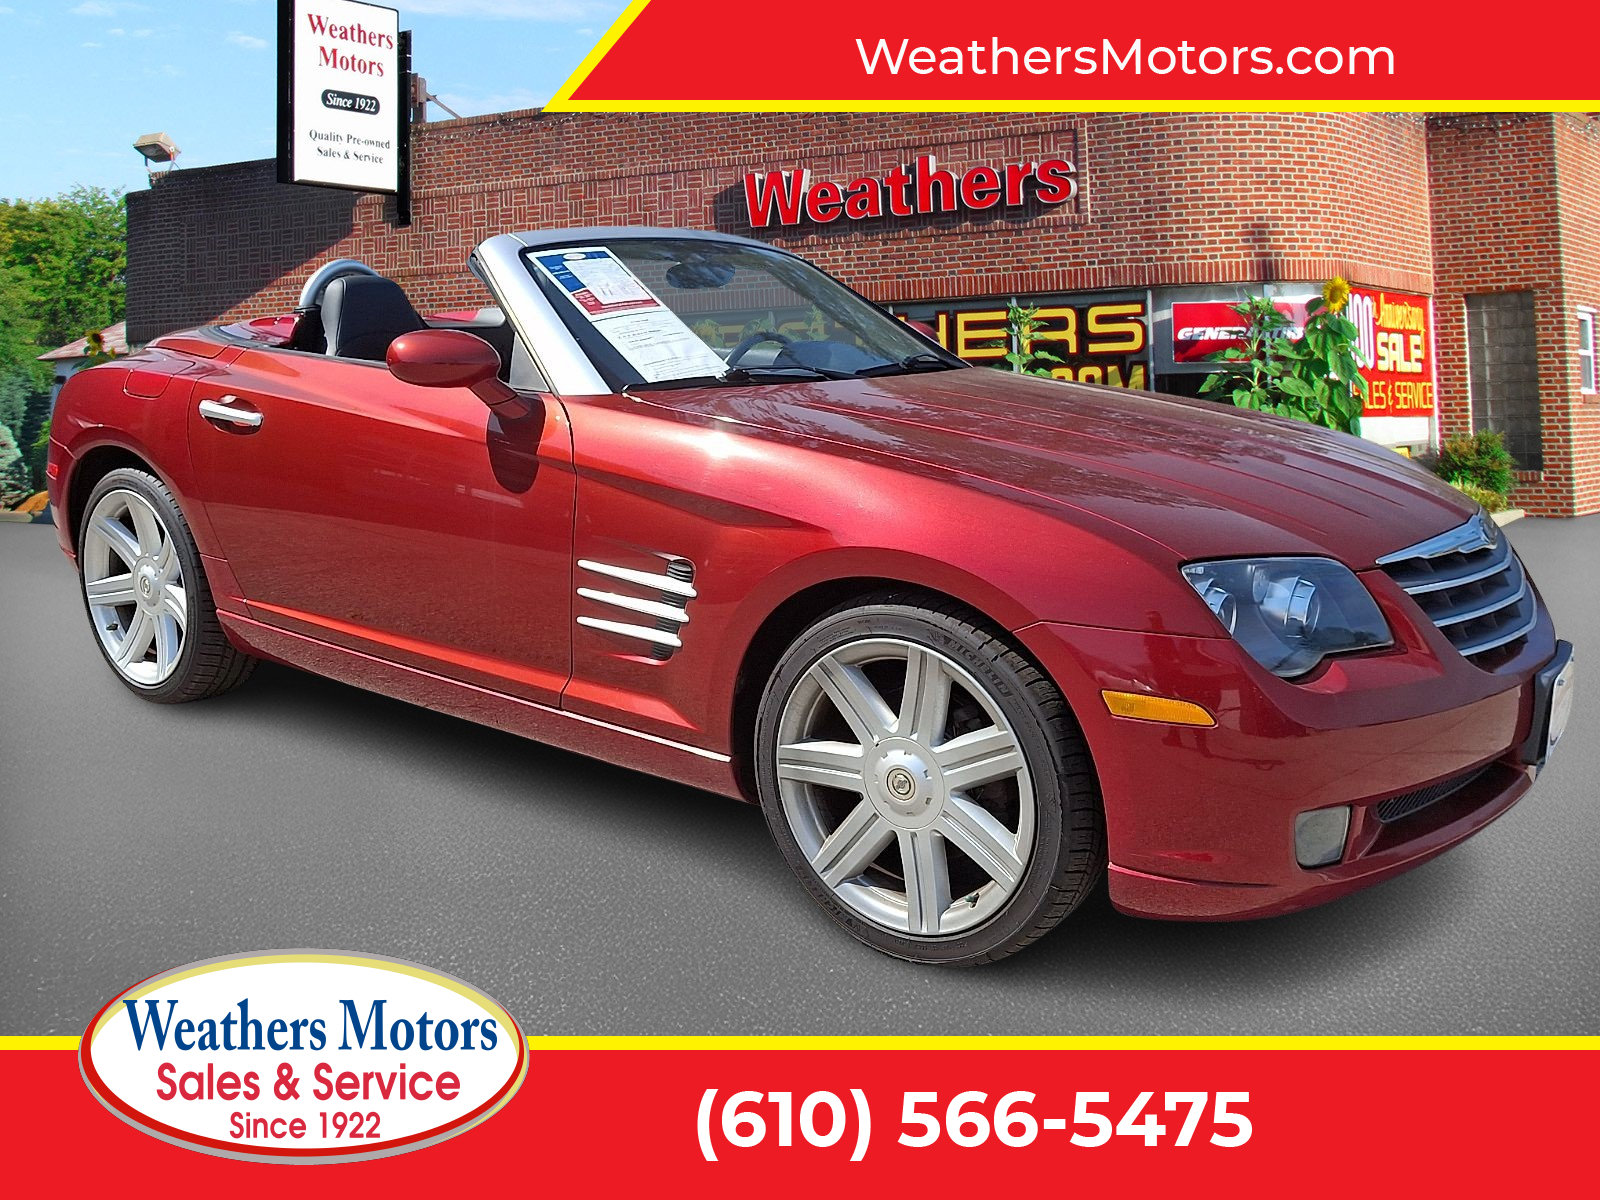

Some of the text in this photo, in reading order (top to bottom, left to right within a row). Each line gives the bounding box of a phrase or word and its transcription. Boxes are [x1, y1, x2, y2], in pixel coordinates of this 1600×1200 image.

[307, 13, 394, 50] Weathers
[319, 46, 384, 77] Motors
[326, 92, 376, 112] Since 1922
[309, 129, 390, 149] Quality Pre-owned
[317, 146, 384, 164] Sales & Service
[744, 155, 1076, 228] Weathers
[1377, 332, 1422, 373] SALE
[1394, 382, 1433, 409] SERVICE
